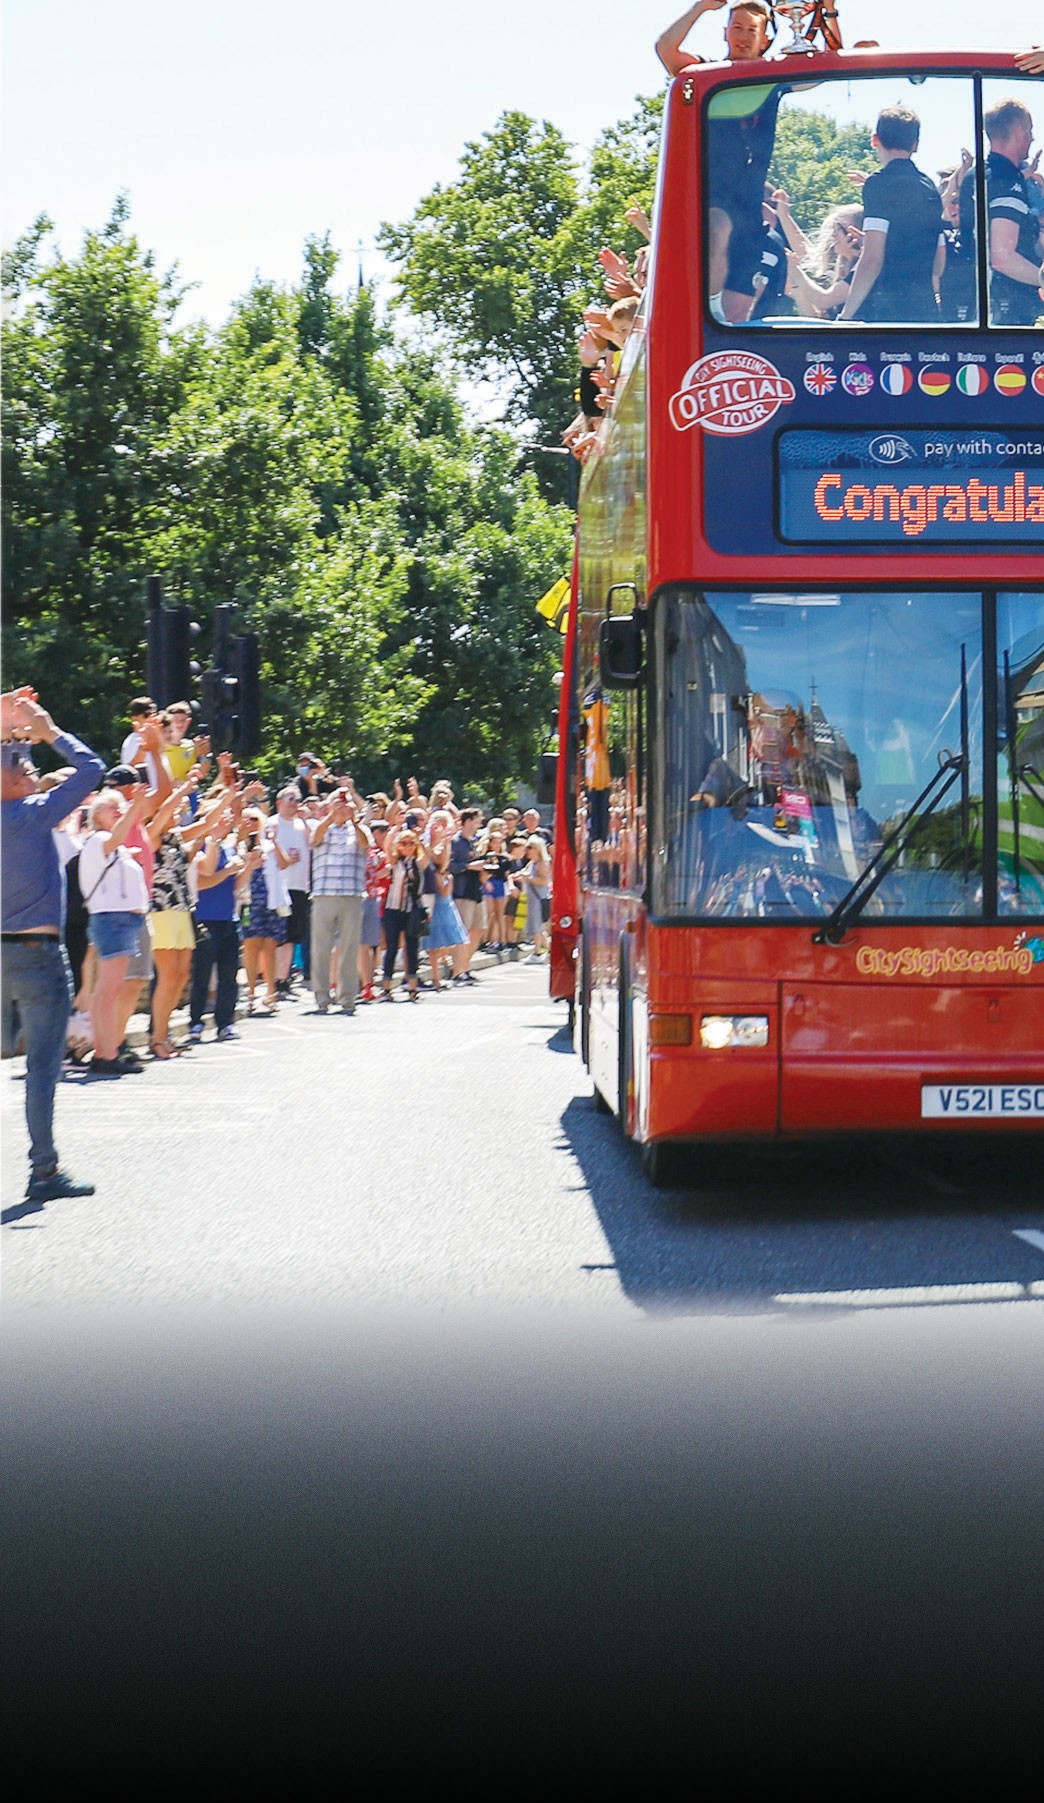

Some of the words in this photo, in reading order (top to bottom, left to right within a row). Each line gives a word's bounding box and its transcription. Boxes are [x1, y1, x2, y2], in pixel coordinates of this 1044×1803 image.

[710, 355, 767, 375] SIGHTSEEING
[678, 380, 791, 420] OFFICIAL
[721, 404, 769, 426] TOUR
[925, 442, 953, 457] pay
[956, 439, 992, 455] with
[939, 1088, 993, 1111] V521
